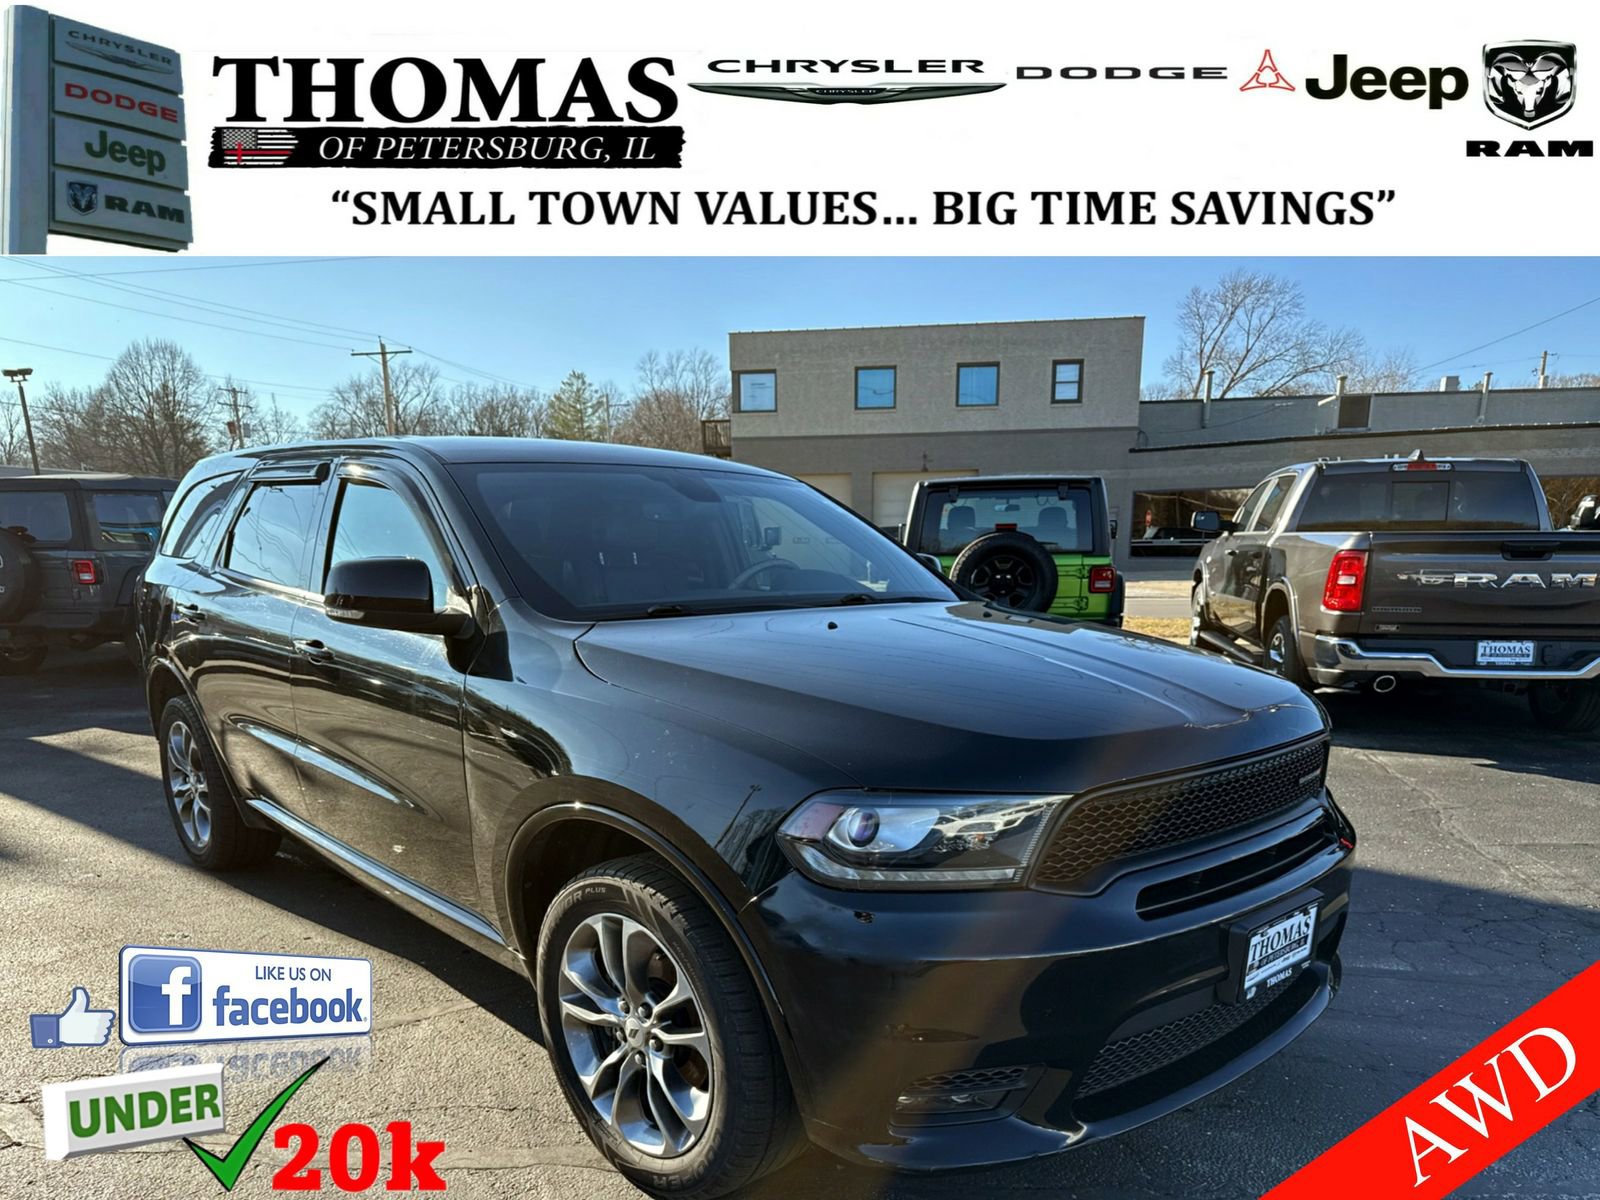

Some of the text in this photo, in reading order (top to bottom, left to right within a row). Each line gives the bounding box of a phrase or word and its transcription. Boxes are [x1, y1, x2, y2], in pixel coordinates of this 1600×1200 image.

[1453, 572, 1598, 589] RAM
[1481, 645, 1531, 654] THOMAS
[585, 887, 607, 895] PLUS
[1251, 915, 1312, 962] THOMAS
